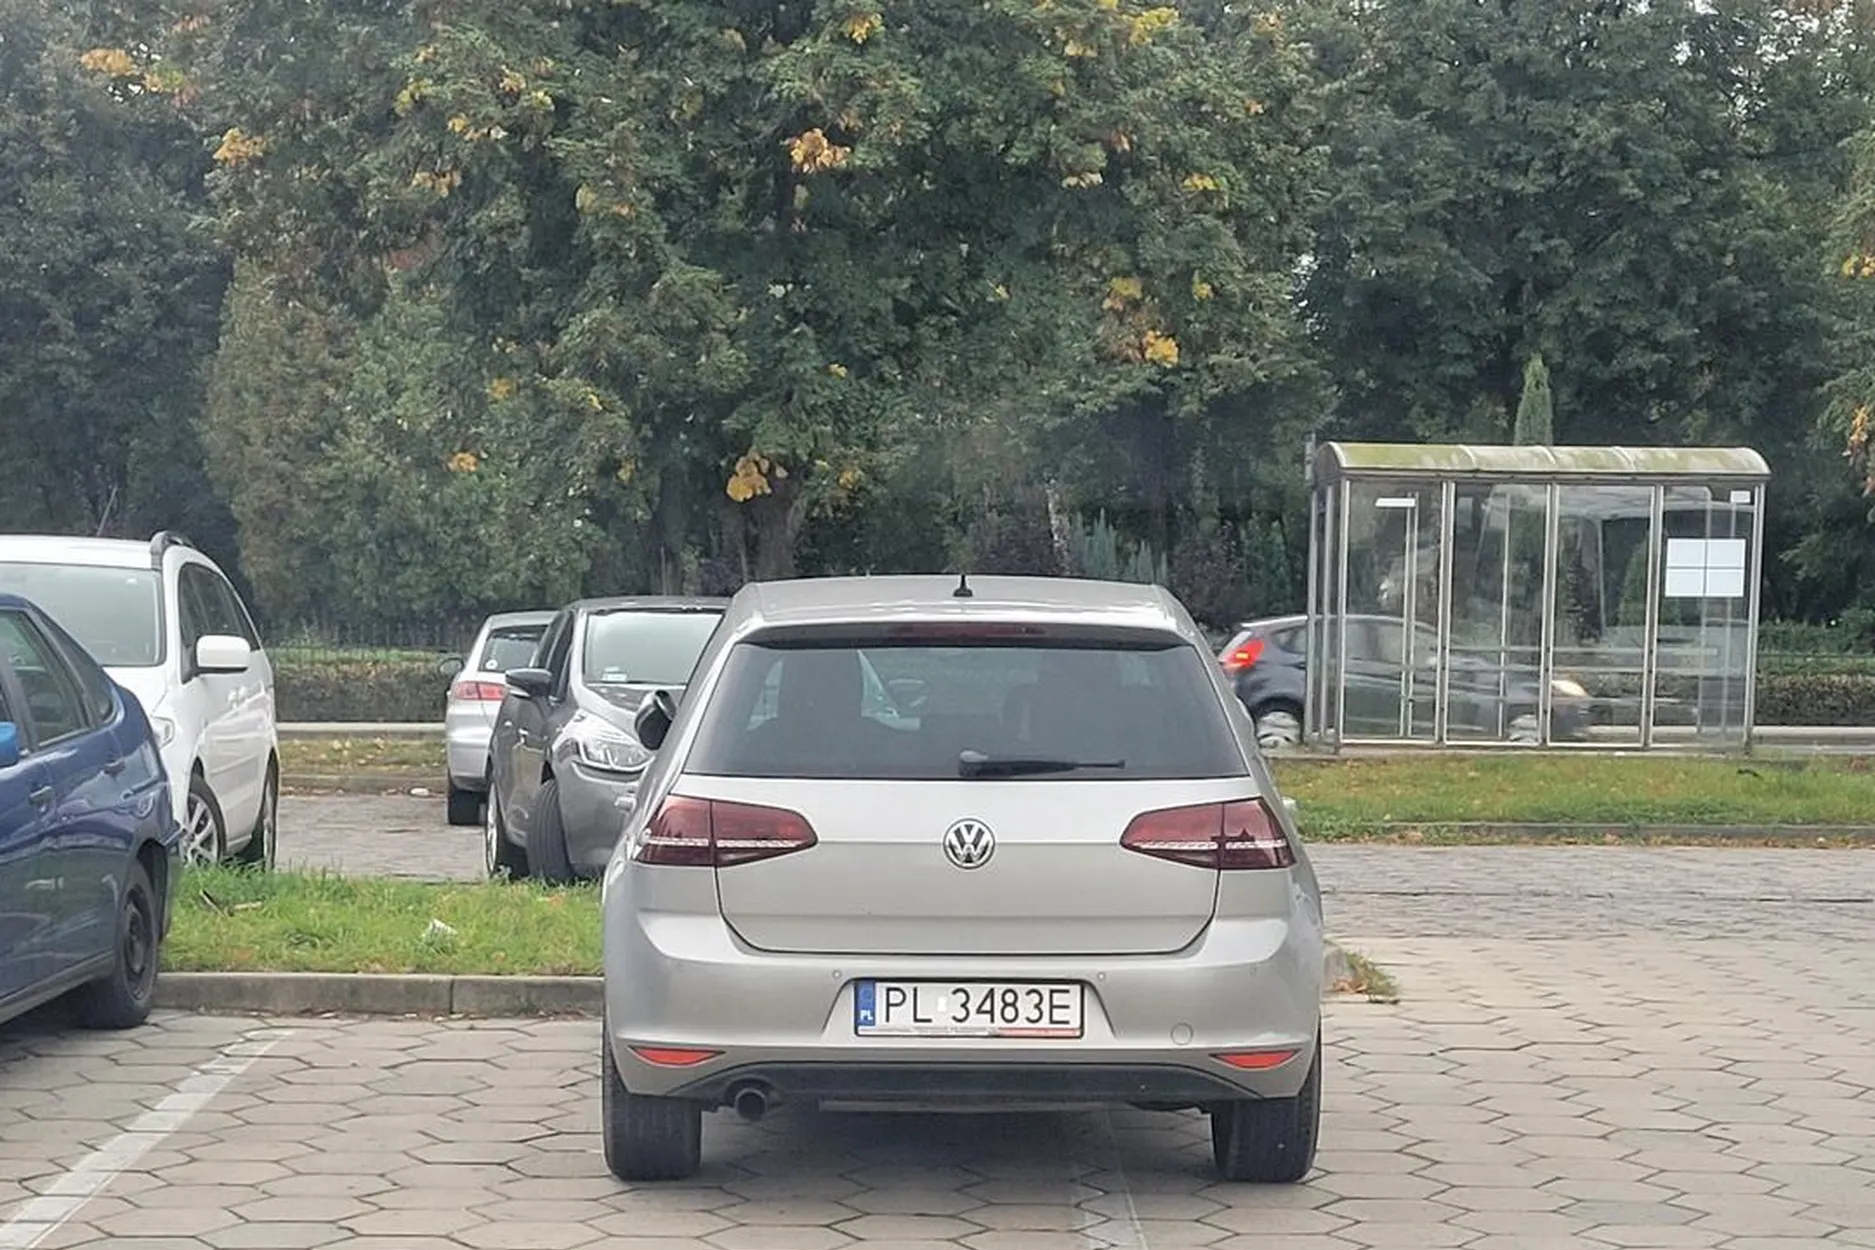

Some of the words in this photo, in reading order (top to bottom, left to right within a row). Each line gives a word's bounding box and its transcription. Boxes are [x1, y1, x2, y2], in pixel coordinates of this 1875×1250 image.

[945, 820, 994, 868] VW
[860, 1009, 874, 1021] PL
[886, 986, 933, 1023] PL
[951, 987, 1071, 1025] 3483E
